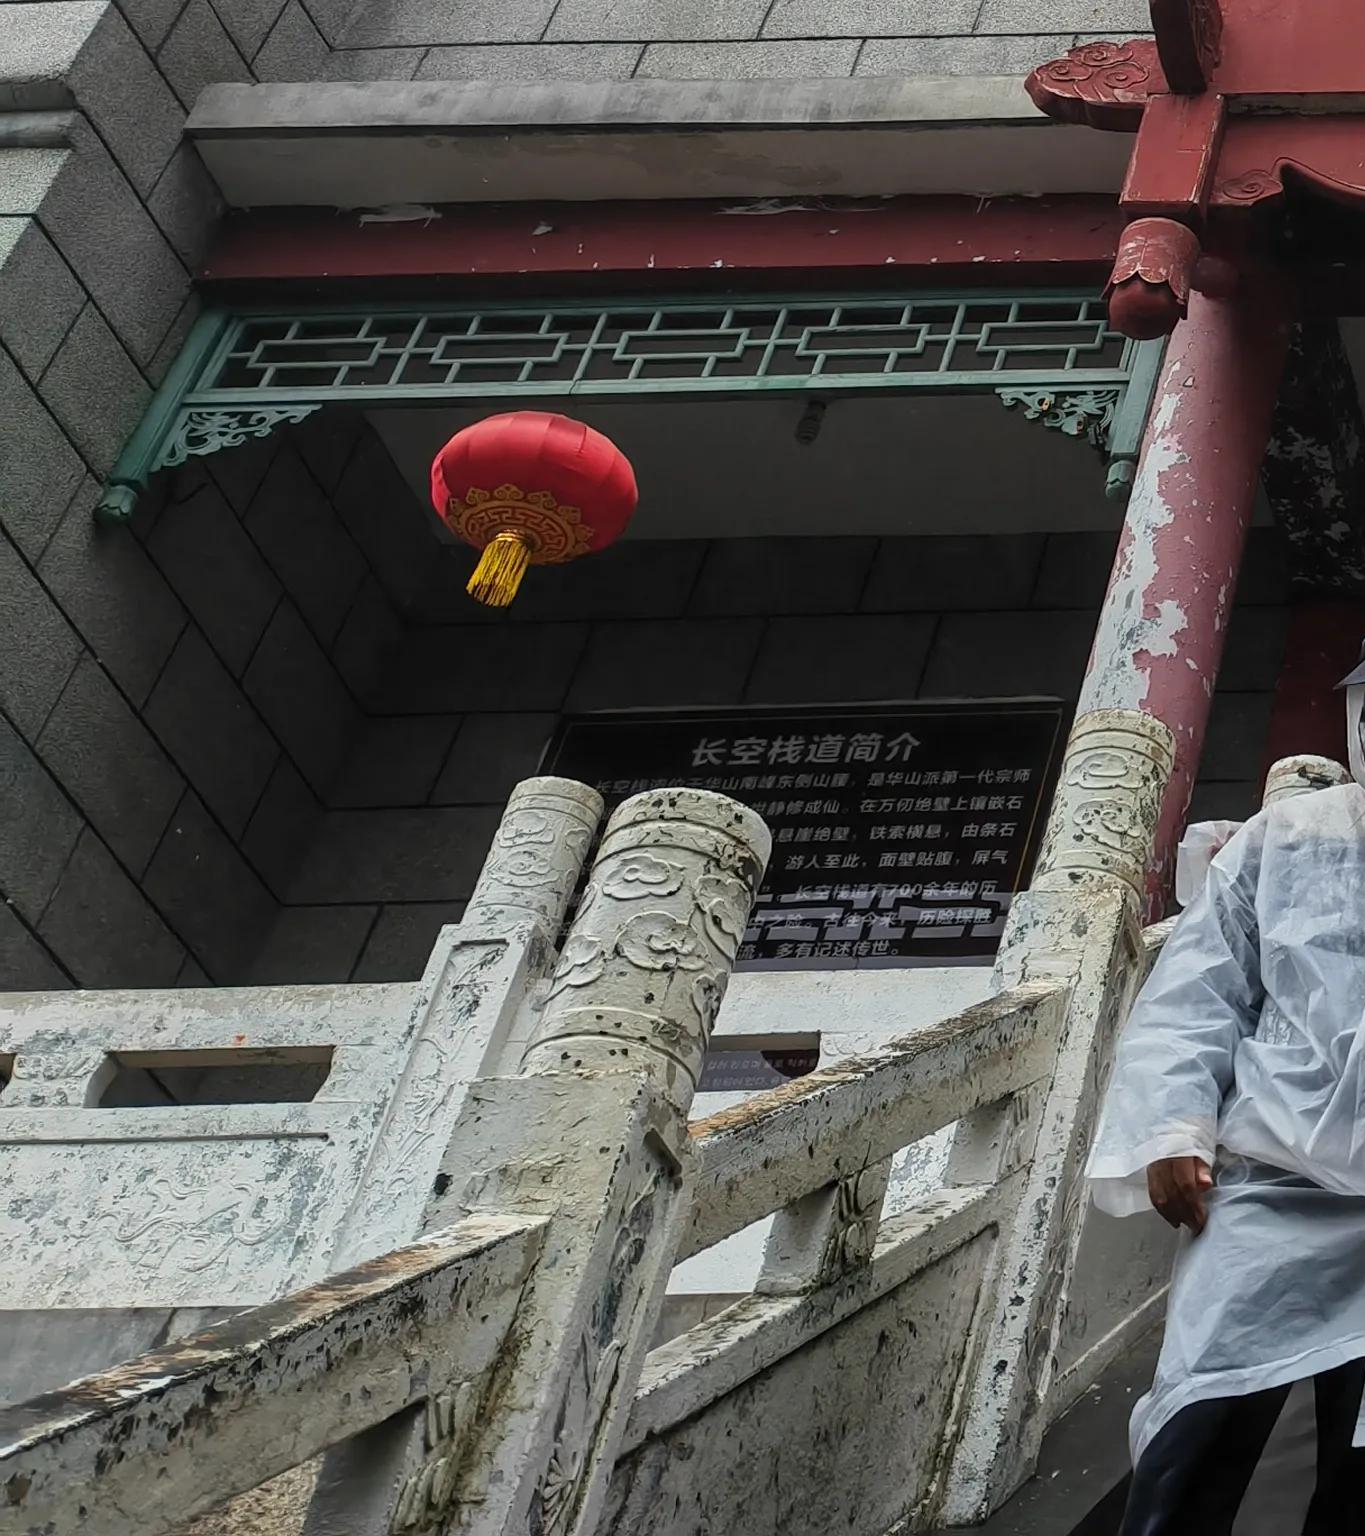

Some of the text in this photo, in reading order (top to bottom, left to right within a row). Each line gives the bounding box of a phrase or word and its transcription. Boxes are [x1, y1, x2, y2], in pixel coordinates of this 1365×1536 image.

[691, 731, 921, 768] 长空栈道简介
